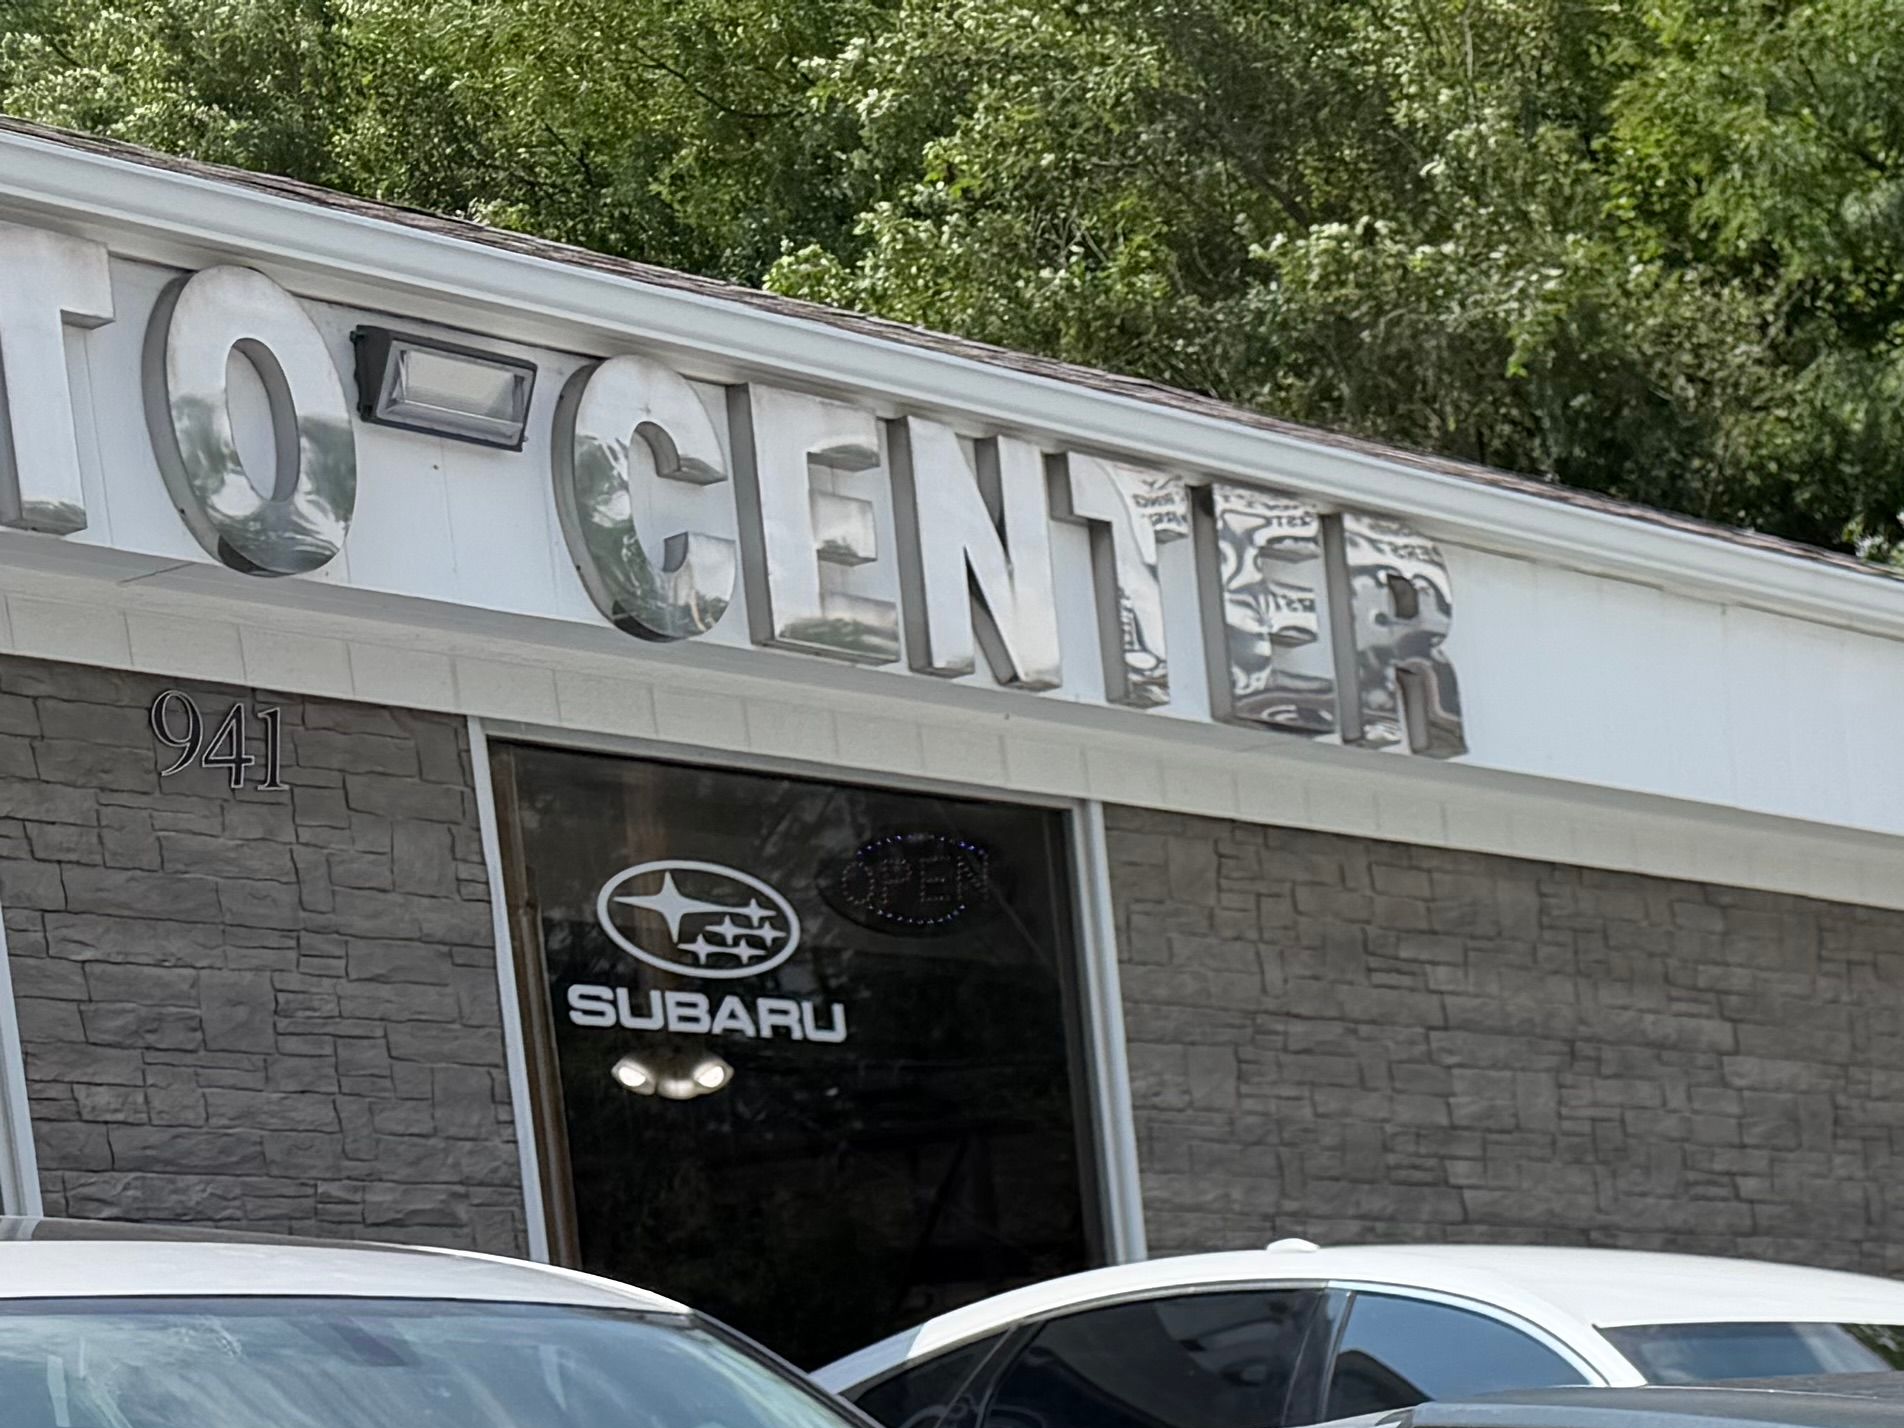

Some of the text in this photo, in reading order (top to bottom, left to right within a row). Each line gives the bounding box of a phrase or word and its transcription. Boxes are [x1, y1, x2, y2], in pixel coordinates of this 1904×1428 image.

[551, 357, 1468, 757] CENTER
[151, 689, 290, 791] 941
[840, 855, 990, 905] OPEN
[566, 982, 848, 1044] SUBARU
